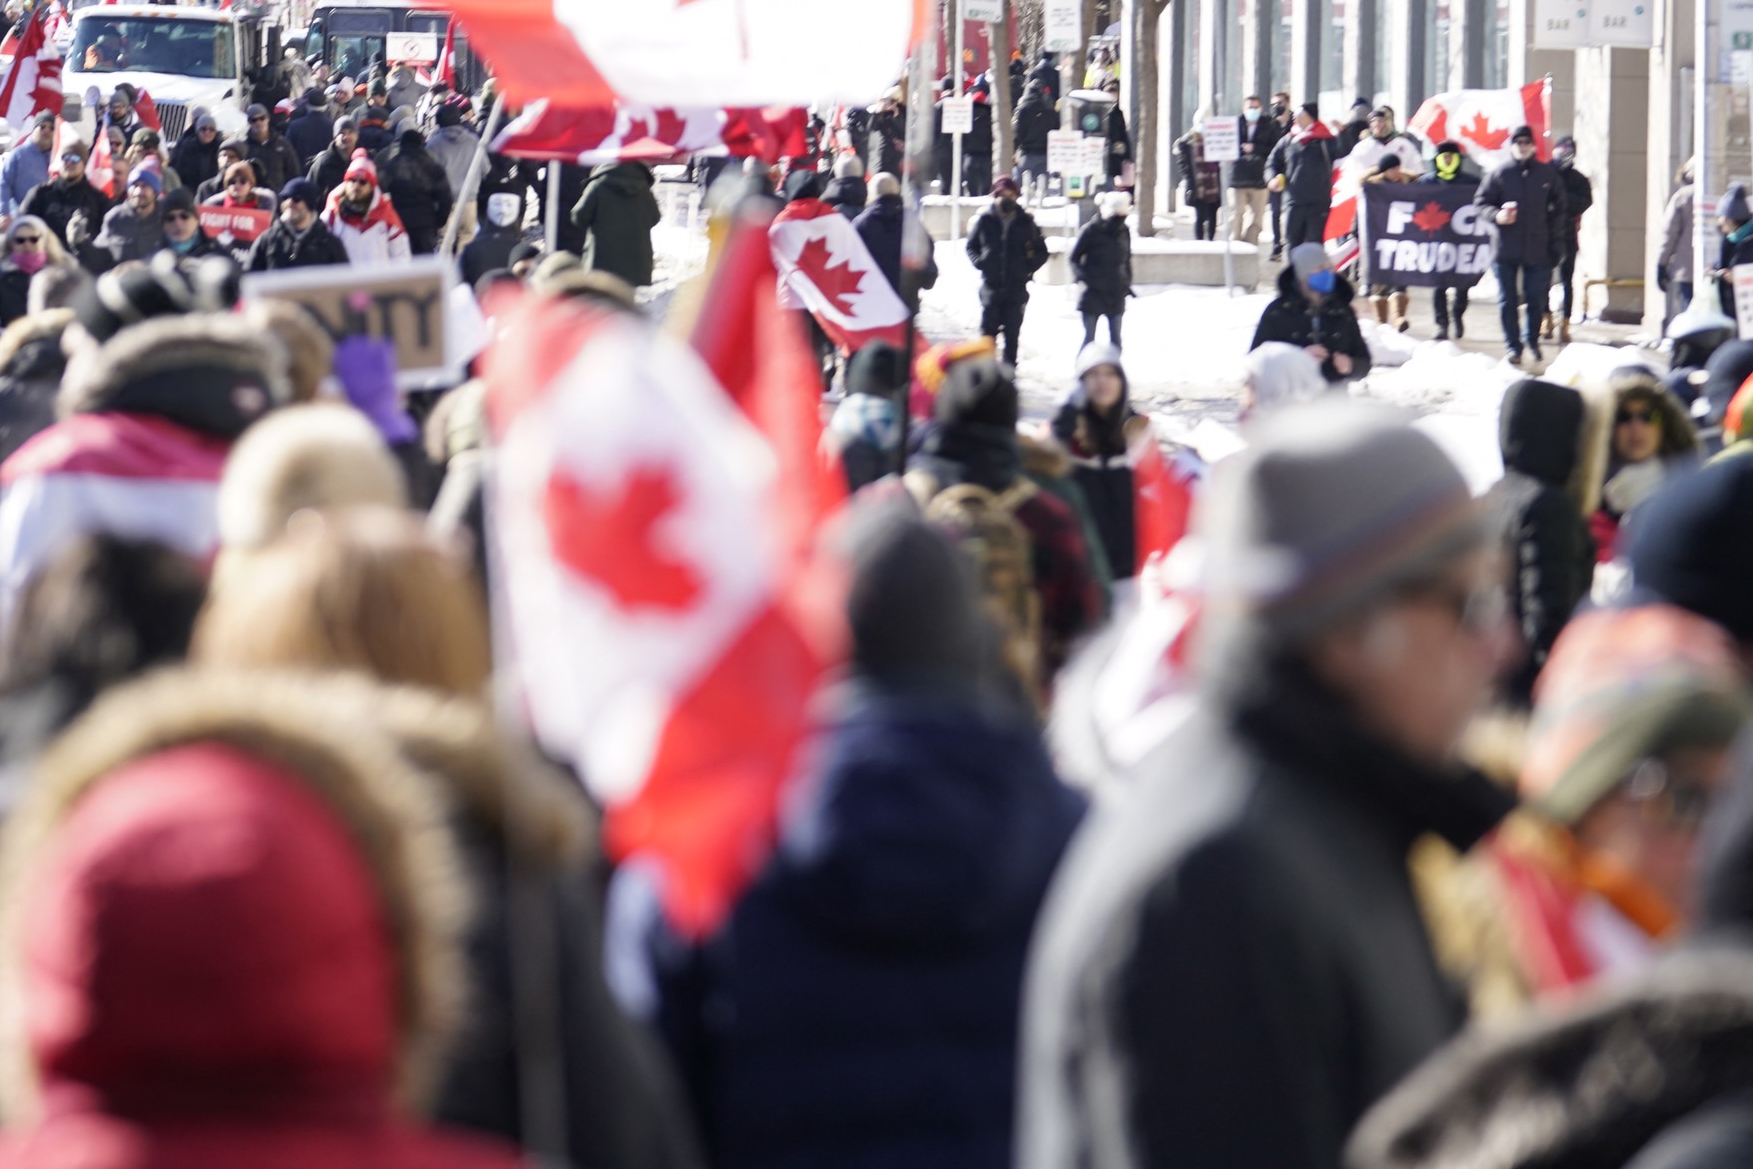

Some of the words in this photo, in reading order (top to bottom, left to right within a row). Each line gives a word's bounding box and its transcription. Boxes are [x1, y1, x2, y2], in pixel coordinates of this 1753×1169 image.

[1547, 19, 1571, 31] BAR
[1603, 15, 1627, 28] BAR
[1375, 238, 1492, 274] TRUDEA
